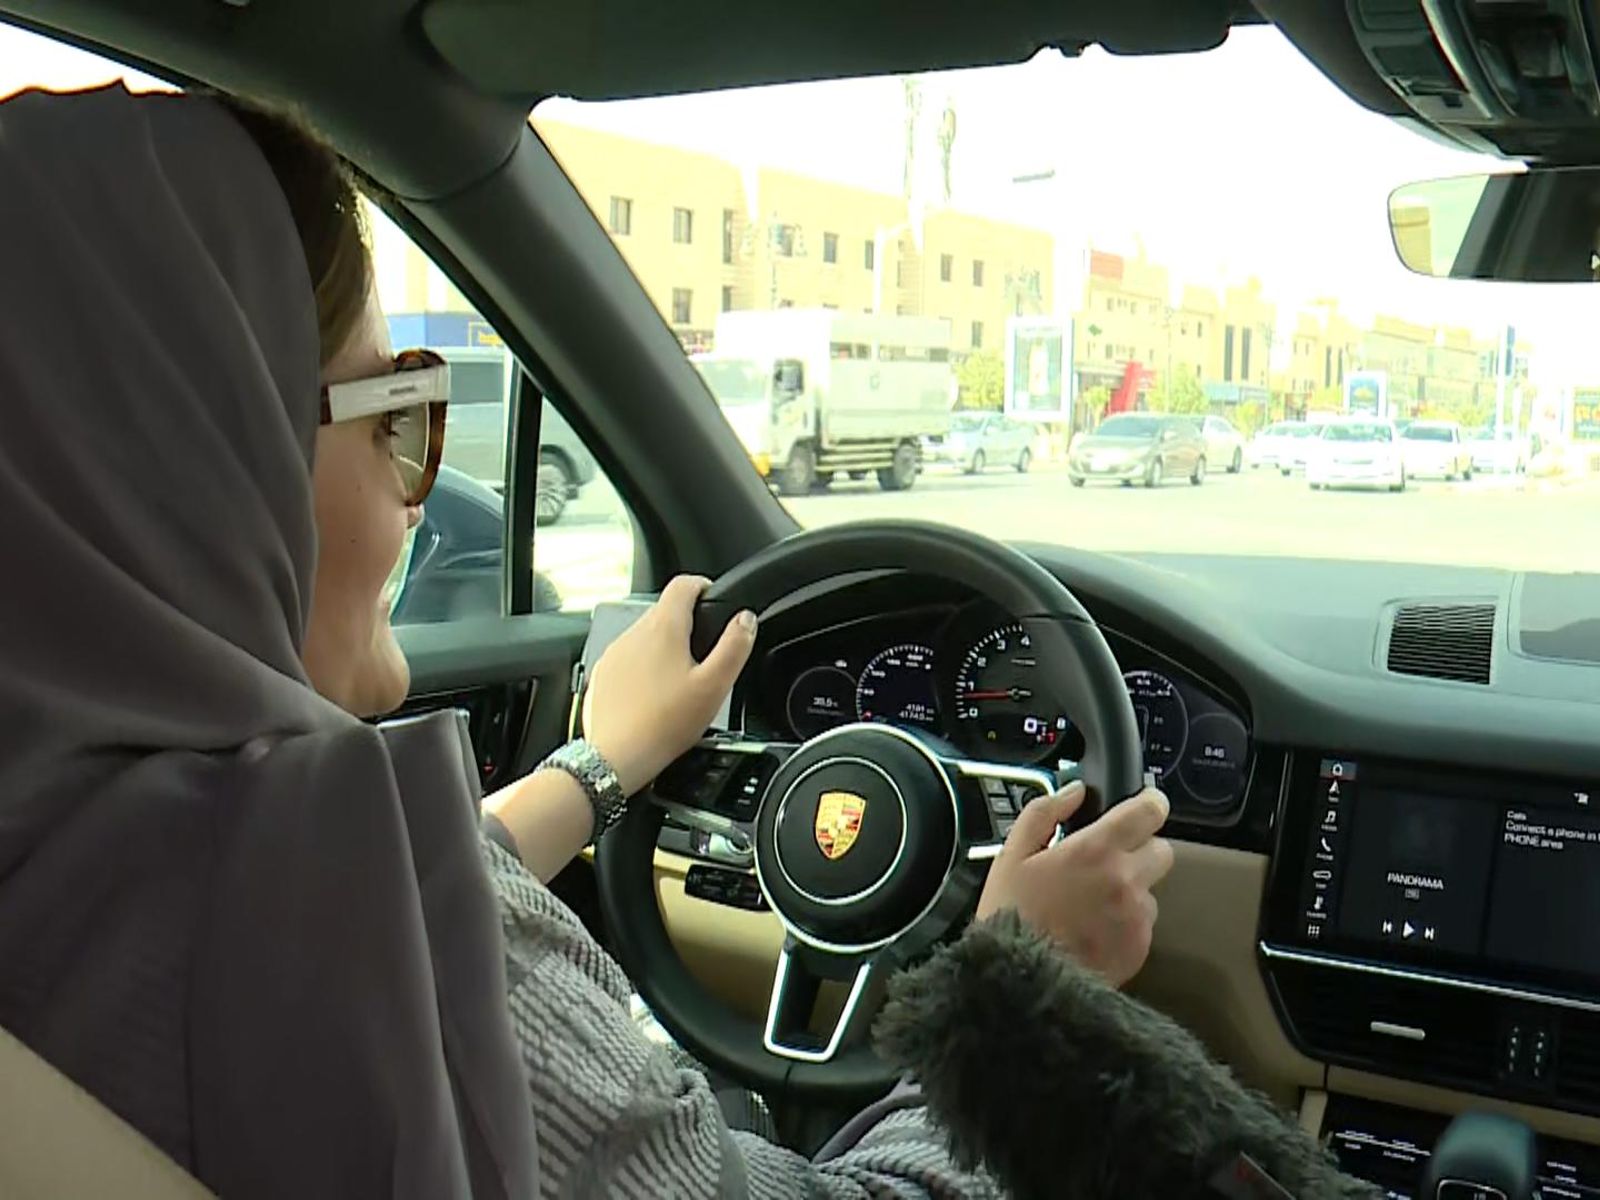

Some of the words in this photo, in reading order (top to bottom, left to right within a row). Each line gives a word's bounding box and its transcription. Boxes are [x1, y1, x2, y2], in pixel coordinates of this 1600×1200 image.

[1504, 832, 1541, 848] PHONE
[1505, 820, 1547, 836] Connect
[1555, 828, 1587, 841] phone
[1386, 871, 1445, 891] PANORAMA
